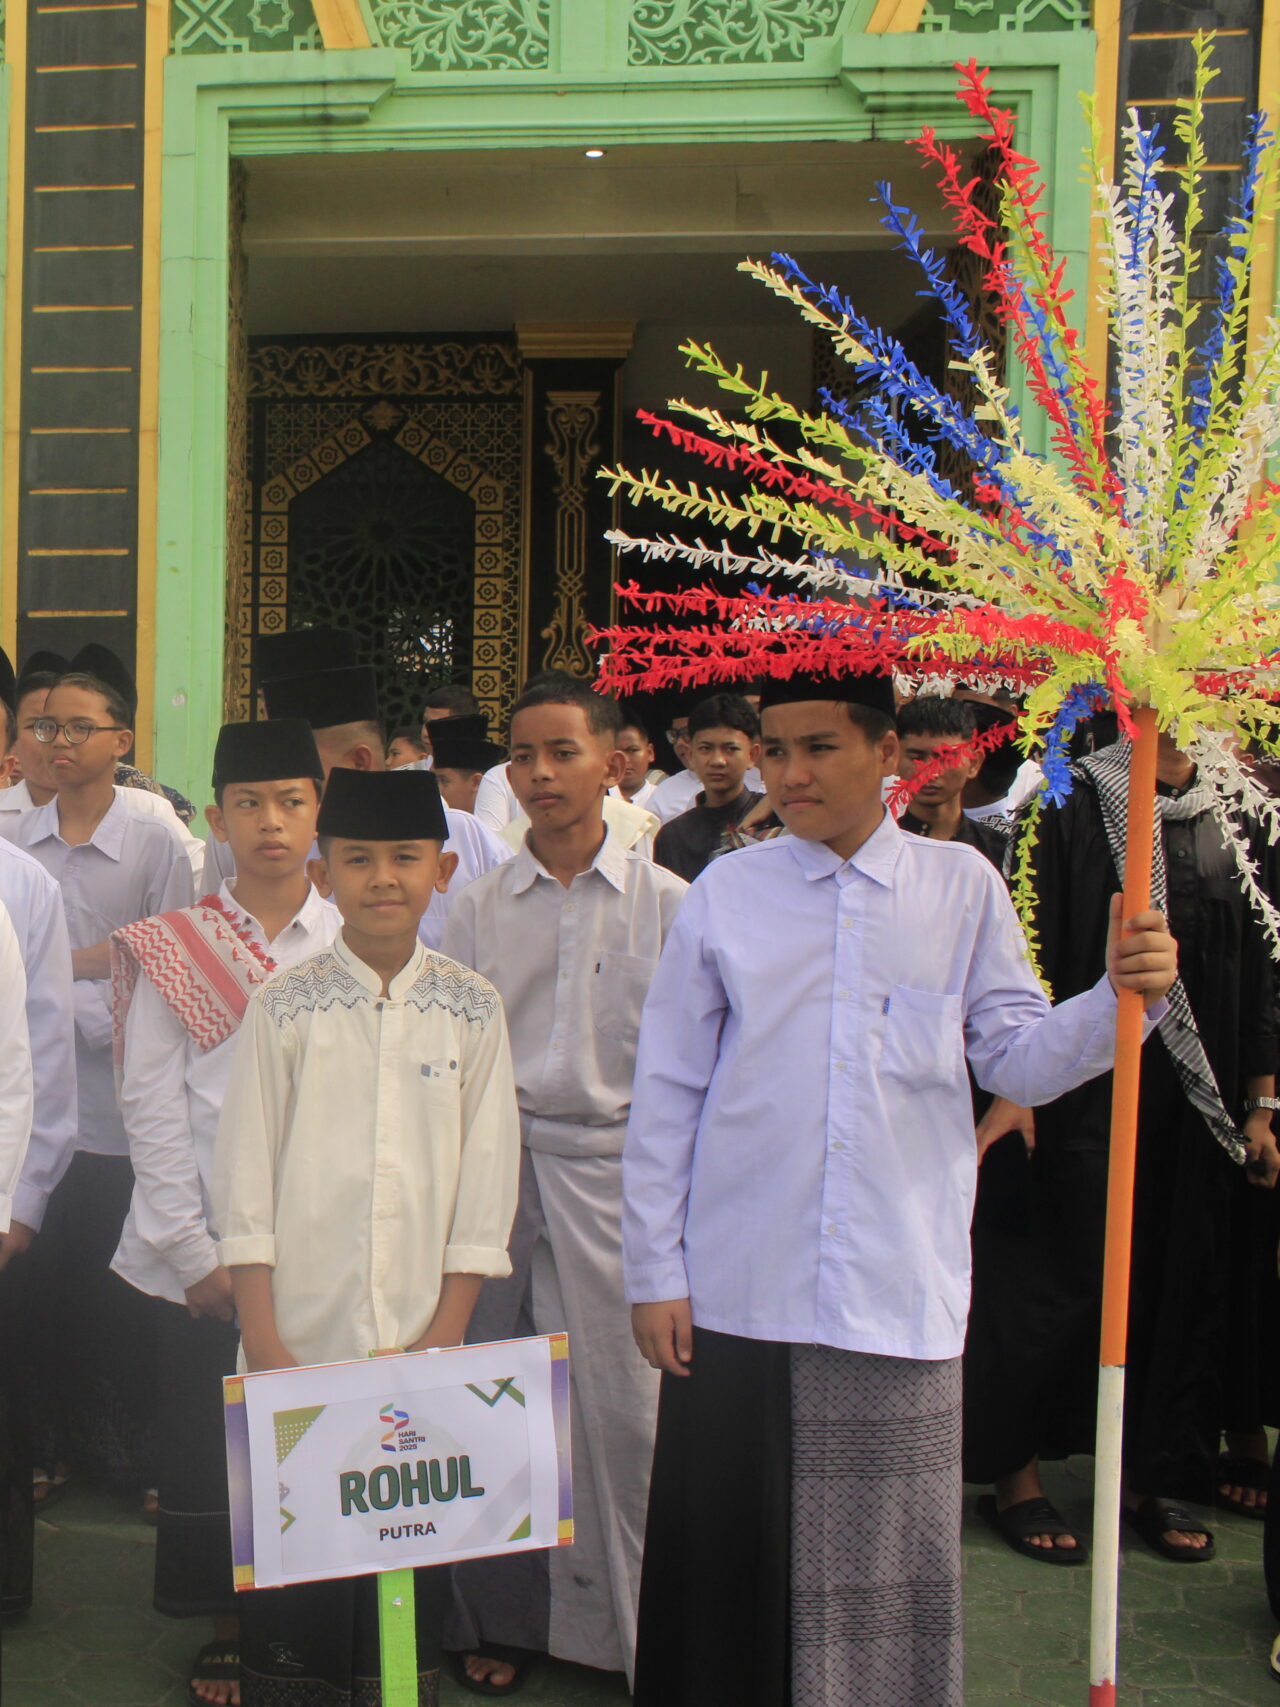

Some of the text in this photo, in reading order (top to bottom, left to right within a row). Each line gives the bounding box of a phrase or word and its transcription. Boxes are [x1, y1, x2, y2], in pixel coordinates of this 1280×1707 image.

[398, 1430, 416, 1438] HARI
[399, 1436, 426, 1445] SANTRI
[399, 1443, 418, 1452] 2025
[340, 1455, 485, 1516] ROHUL
[379, 1521, 437, 1541] PUTRA
